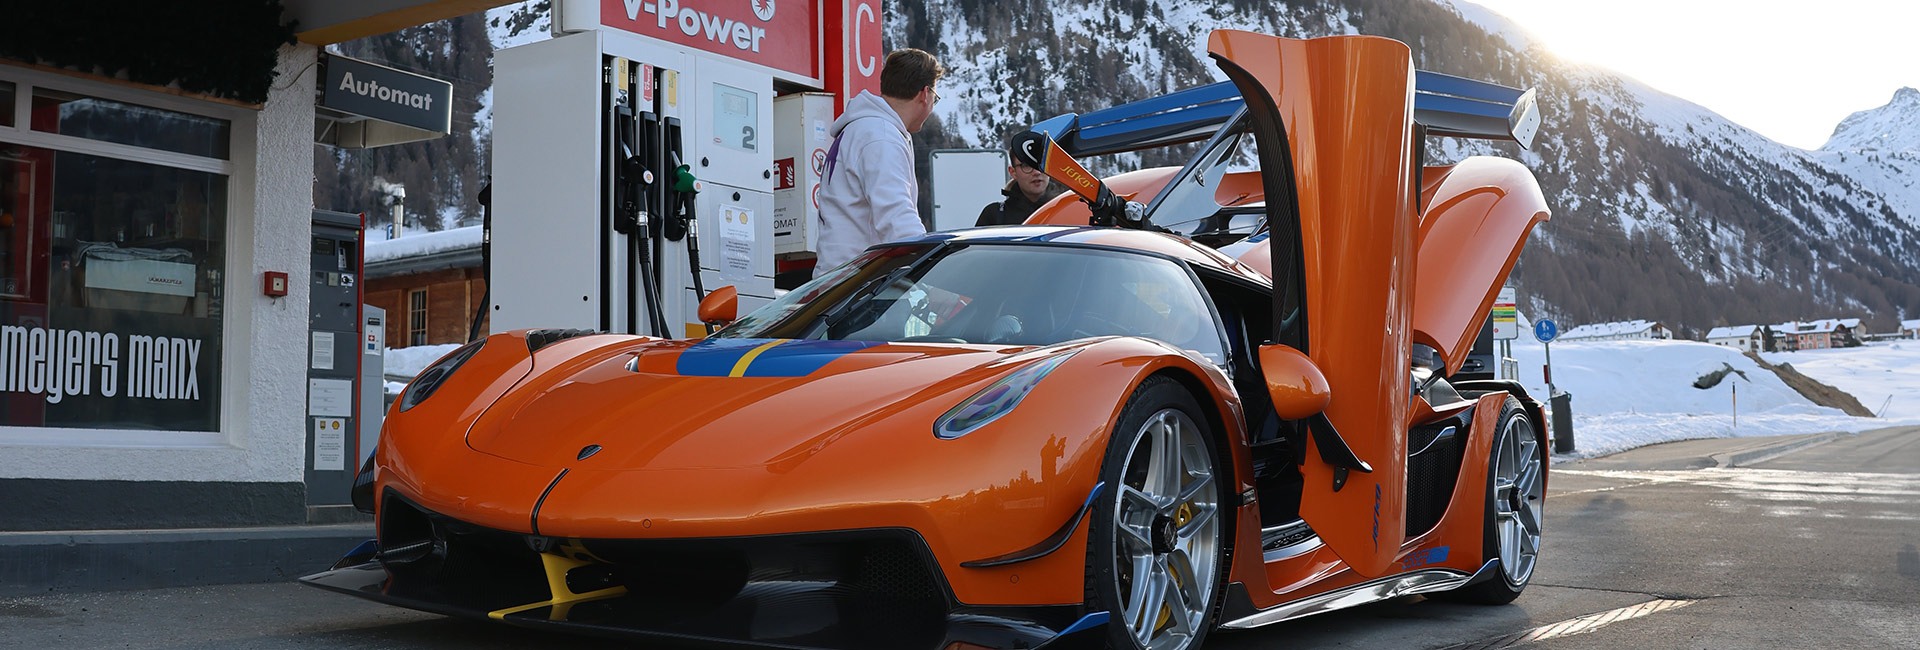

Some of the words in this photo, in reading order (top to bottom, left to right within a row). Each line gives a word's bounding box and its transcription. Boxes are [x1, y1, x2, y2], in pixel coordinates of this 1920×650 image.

[622, 0, 766, 53] V-Power
[855, 2, 876, 77] C
[339, 71, 433, 111] Automat
[742, 125, 755, 150] 2
[774, 218, 798, 230] OMAT
[0, 325, 120, 404] meyers
[127, 334, 201, 400] manx
